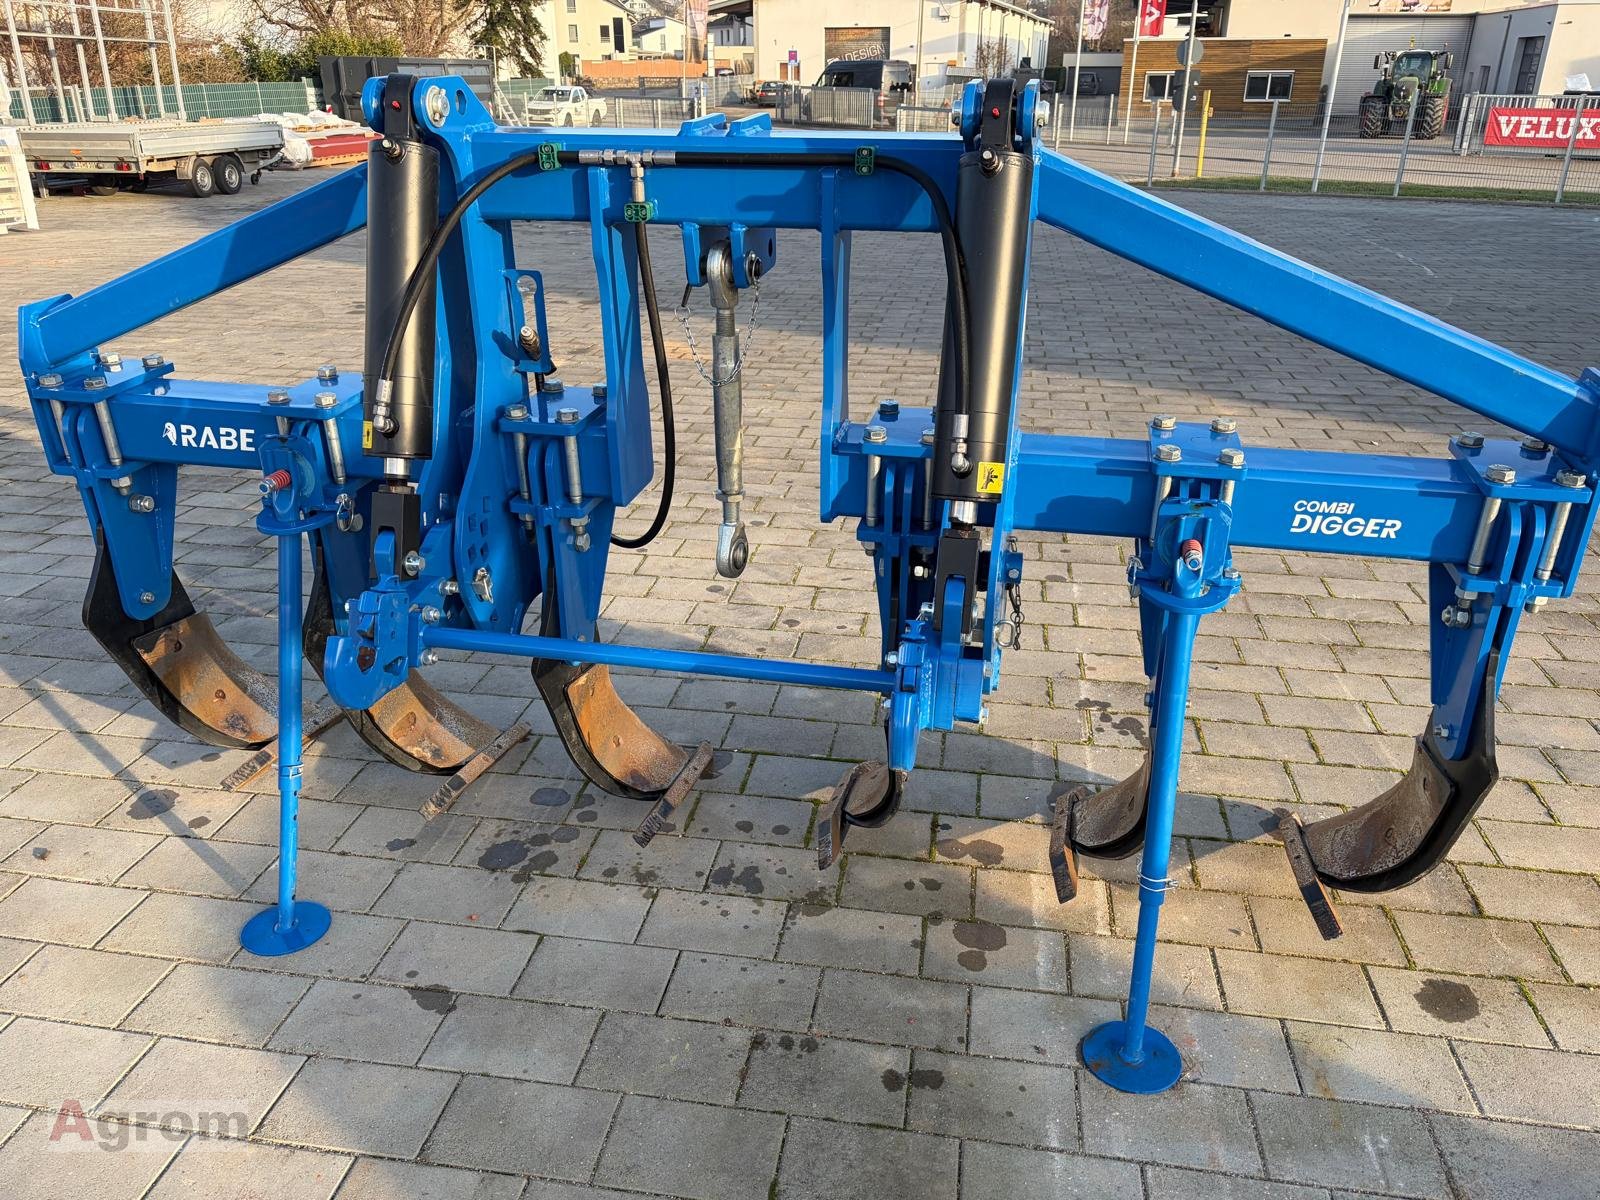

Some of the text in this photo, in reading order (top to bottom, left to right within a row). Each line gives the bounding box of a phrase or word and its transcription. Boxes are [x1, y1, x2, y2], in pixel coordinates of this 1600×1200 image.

[1497, 115, 1600, 140] VELUX
[180, 424, 256, 452] RABE
[1293, 499, 1356, 515] COMBI
[1290, 514, 1403, 539] DIGGER
